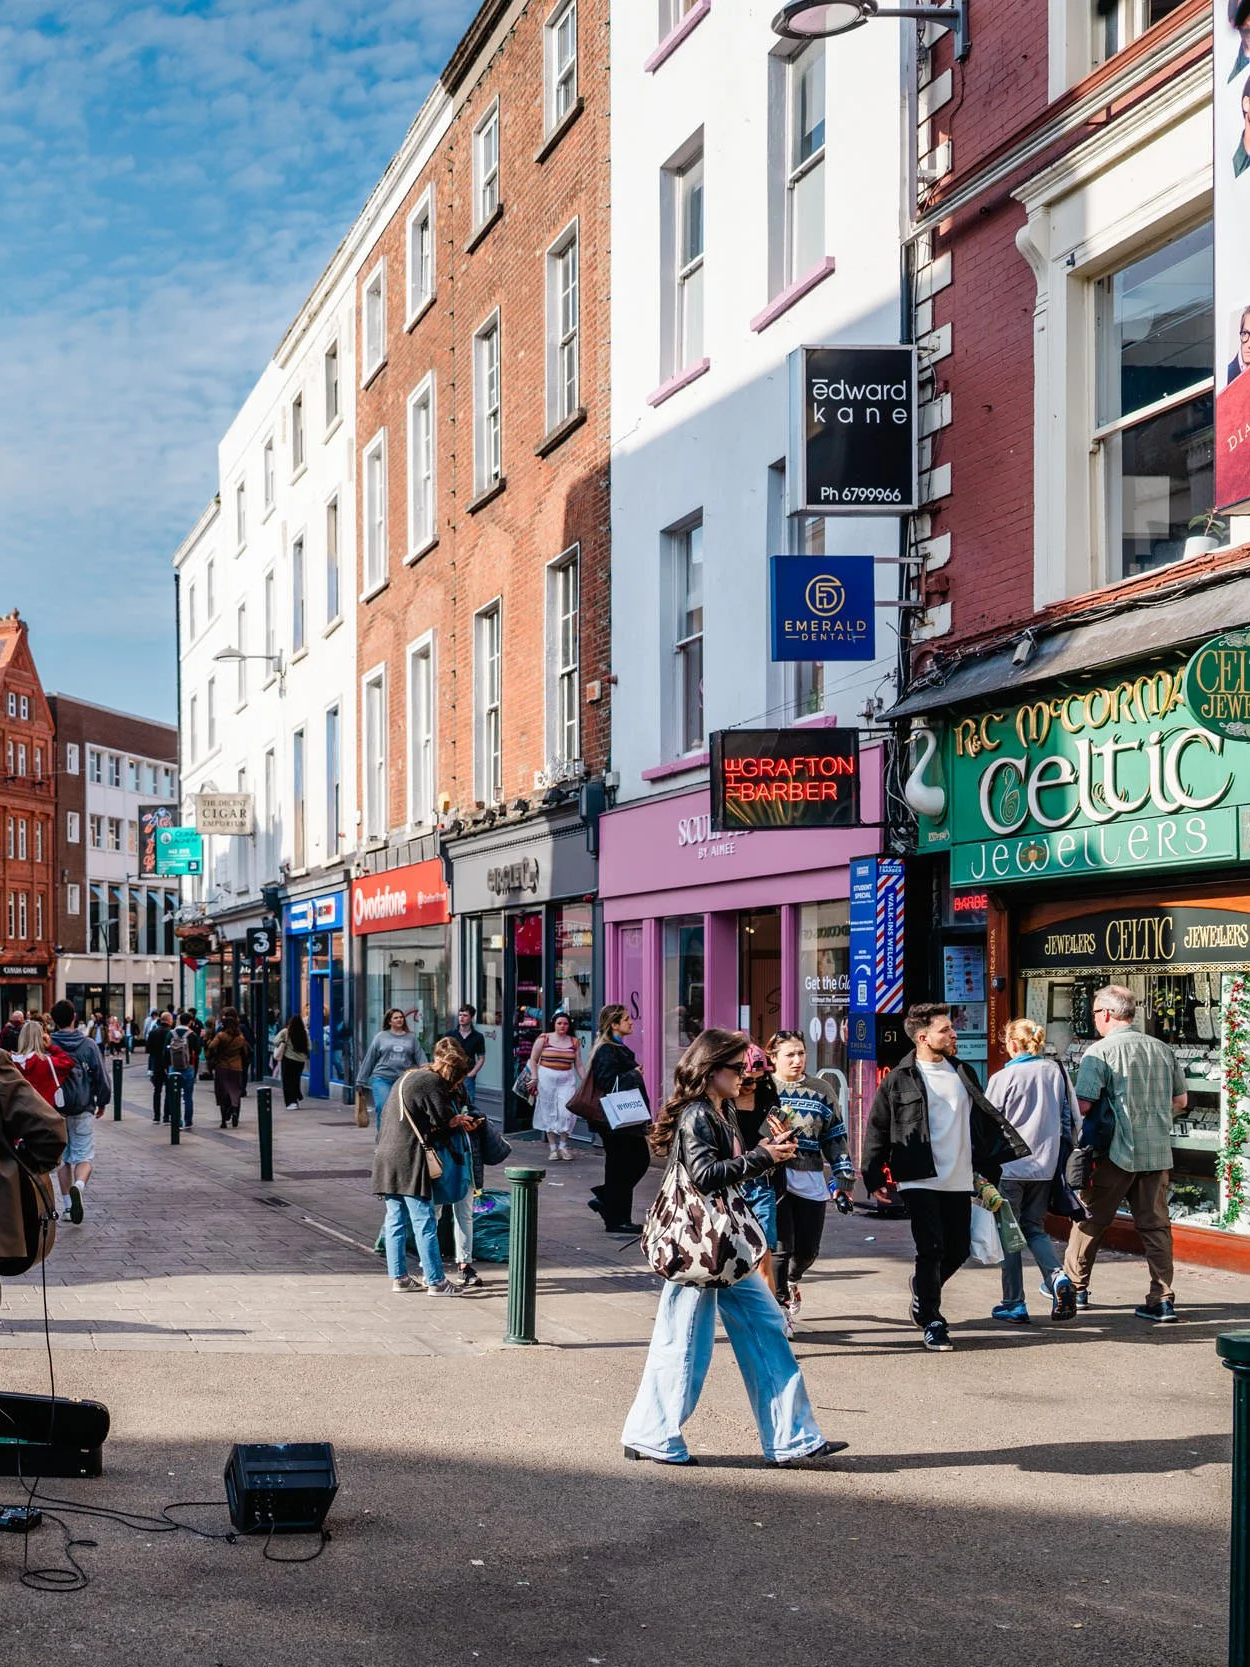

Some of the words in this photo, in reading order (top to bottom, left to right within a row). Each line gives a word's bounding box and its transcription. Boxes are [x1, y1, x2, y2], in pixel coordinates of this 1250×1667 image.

[820, 487, 838, 501] Ph
[841, 488, 901, 502] 6799966
[785, 620, 867, 633] EMERALD
[801, 633, 854, 642] DENTAL
[1196, 649, 1250, 694] CEL
[741, 756, 854, 778] GRAFTON
[725, 757, 741, 799] THE
[980, 728, 1235, 836] Celtic
[740, 781, 838, 801] BARBER
[202, 808, 247, 819] CIGAR
[698, 847, 707, 859] BY
[710, 843, 735, 857] AIMEE
[363, 885, 406, 920] vodafone
[954, 894, 988, 911] BARBE
[253, 931, 271, 953] 3
[1044, 933, 1097, 956] JEWELLERS
[1106, 917, 1176, 962] CELTIC
[1184, 923, 1249, 949] JEWELLERS
[805, 976, 820, 990] Get
[822, 976, 836, 990] the
[838, 975, 850, 990] Glo
[883, 1031, 897, 1043] 51
